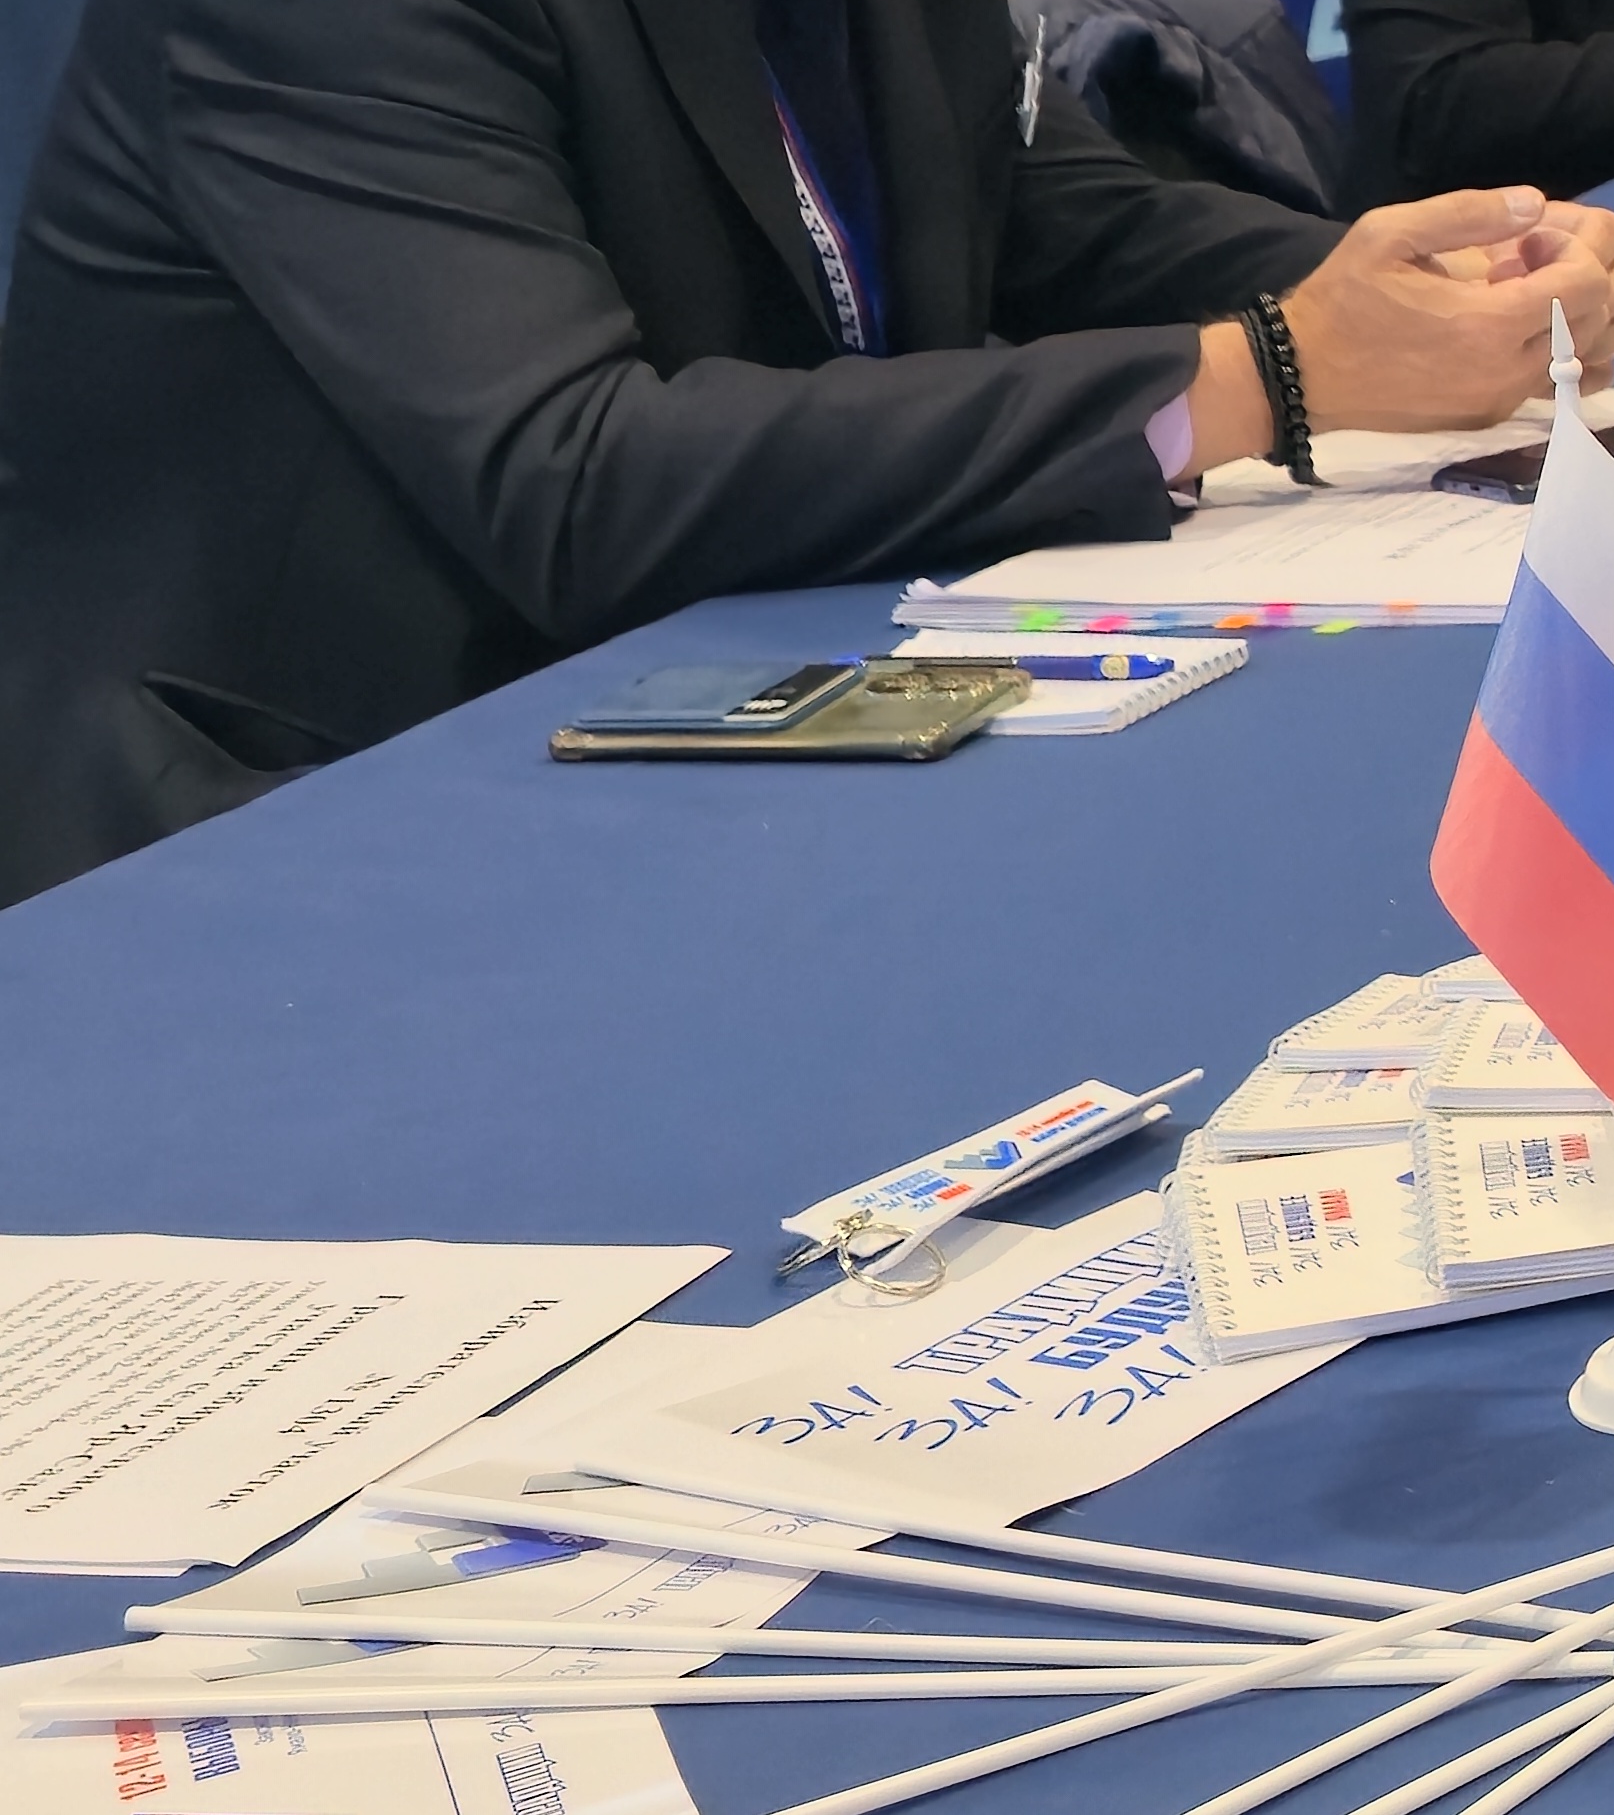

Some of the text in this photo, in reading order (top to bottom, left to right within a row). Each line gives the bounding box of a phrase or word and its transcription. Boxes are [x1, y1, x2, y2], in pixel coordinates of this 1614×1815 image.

[23, 1293, 409, 1514] Границы избирательного
[204, 1298, 564, 1511] Избирательный участок
[275, 1397, 357, 1437] 1304
[730, 1385, 893, 1445] ЗА!
[873, 1377, 1033, 1450] ЗА!
[1054, 1343, 1207, 1425] ЗА!
